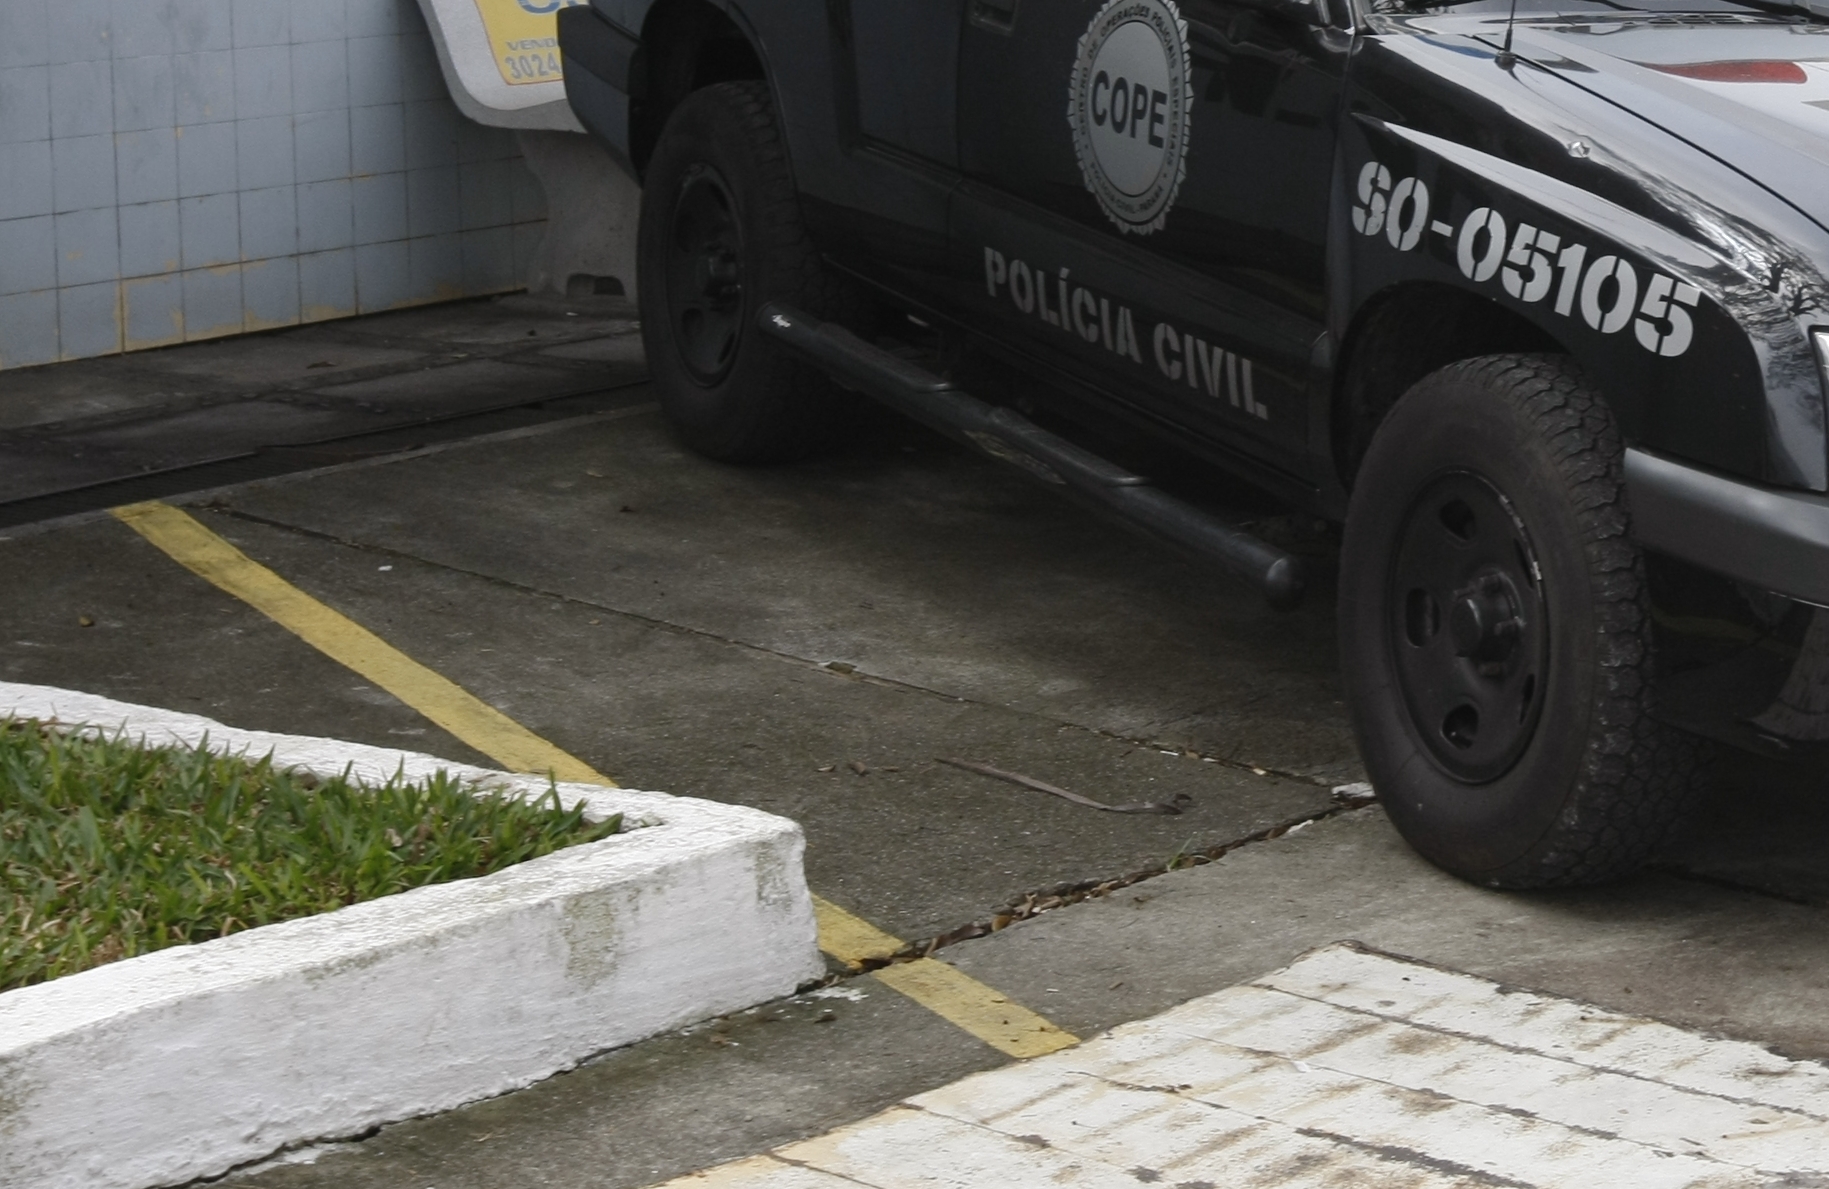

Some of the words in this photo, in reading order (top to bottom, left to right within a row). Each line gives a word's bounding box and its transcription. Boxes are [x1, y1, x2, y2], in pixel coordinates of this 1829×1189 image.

[1091, 70, 1168, 149] COPE
[983, 247, 1143, 365] POLÍCIA
[1152, 323, 1269, 421] CIVIL
[1352, 160, 1701, 358] SO-05105
